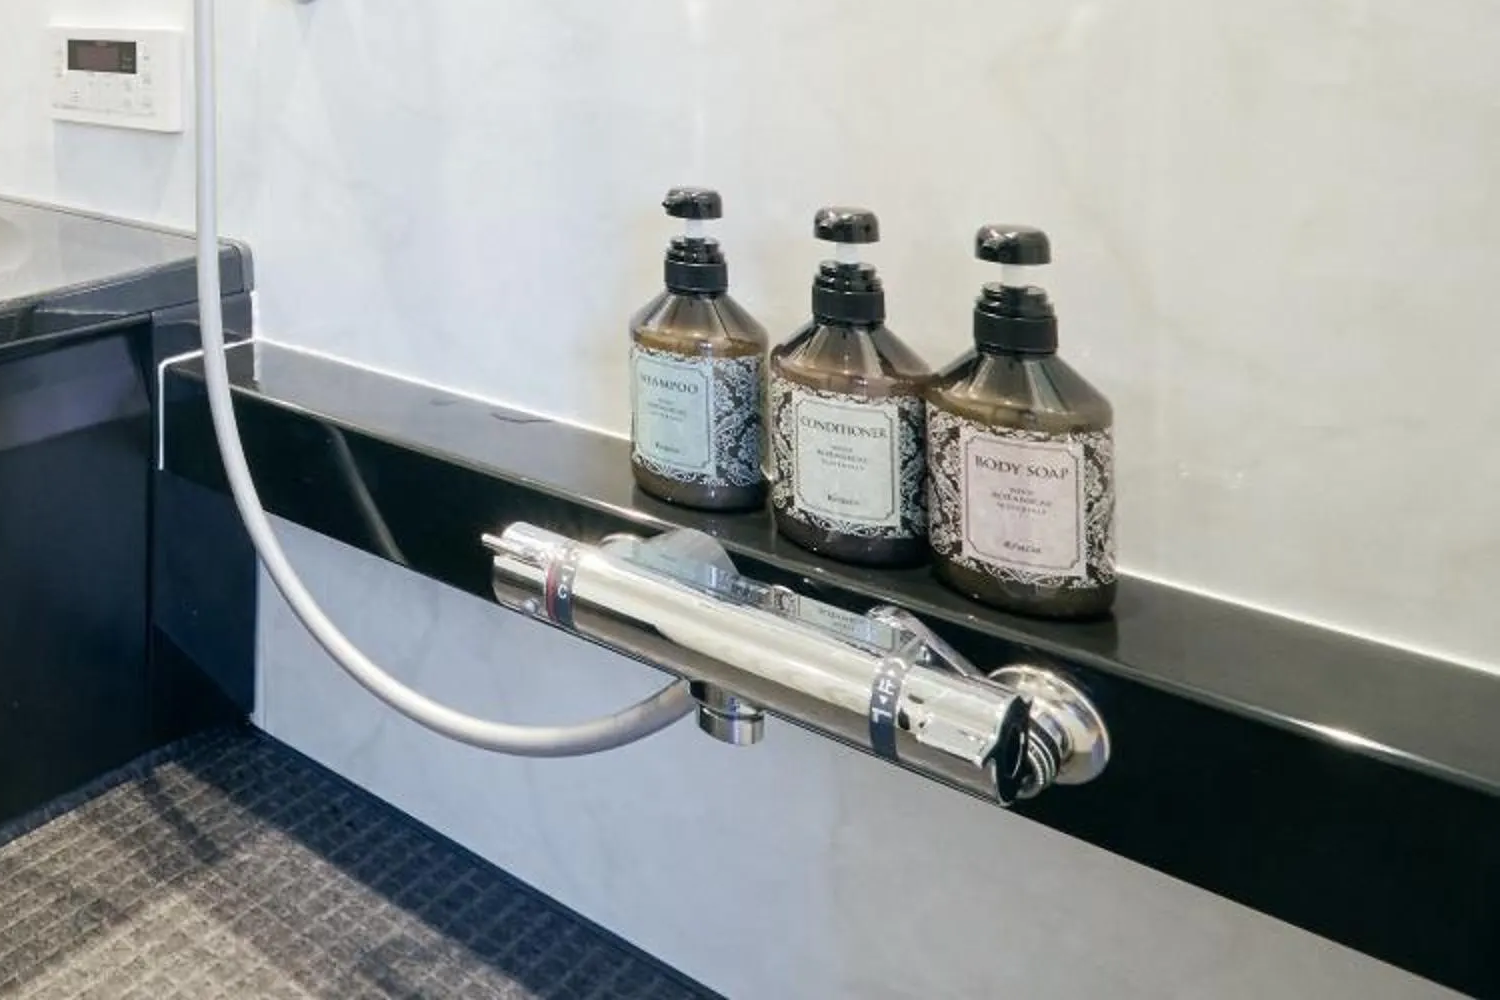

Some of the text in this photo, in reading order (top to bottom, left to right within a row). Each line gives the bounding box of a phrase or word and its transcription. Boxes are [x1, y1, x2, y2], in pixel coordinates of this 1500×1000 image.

[801, 415, 888, 439] CONDITIONER
[975, 455, 1069, 480] BODY SOAP
